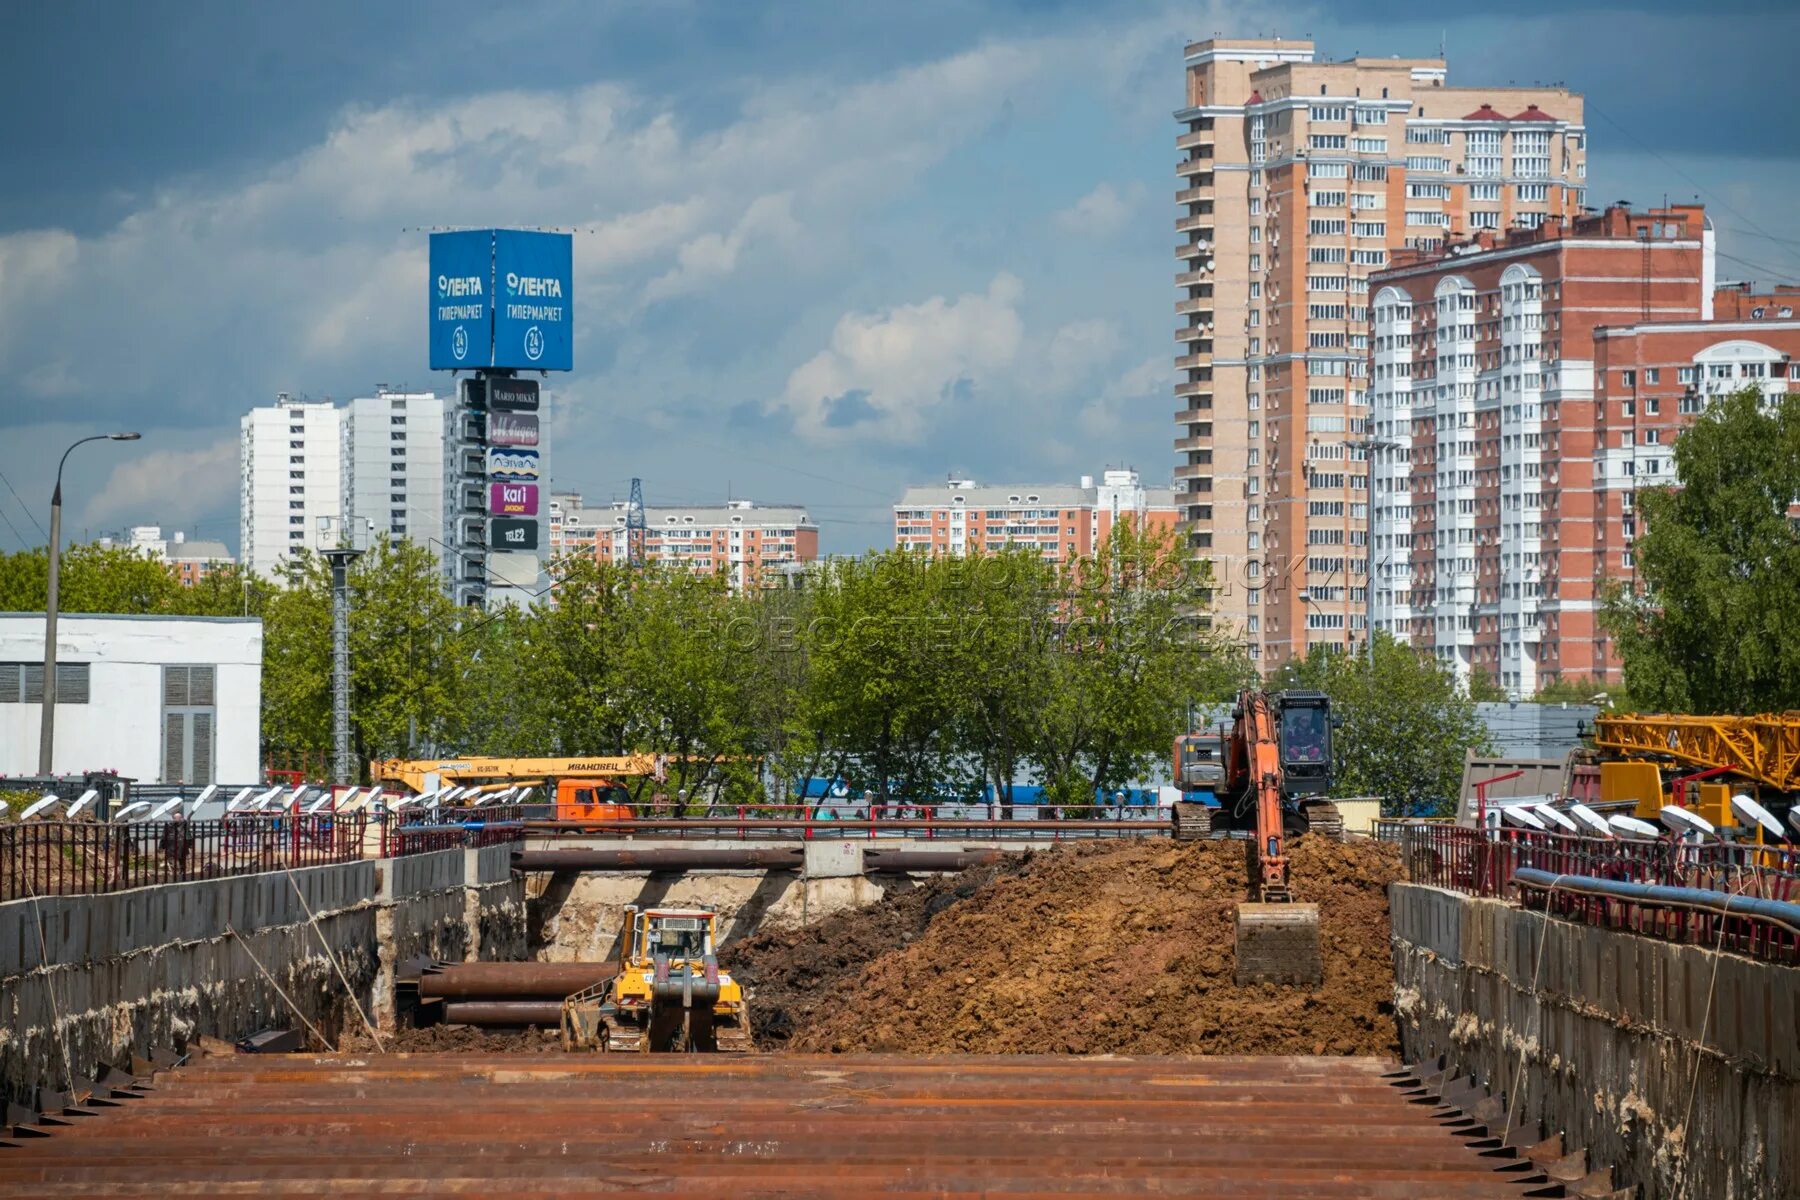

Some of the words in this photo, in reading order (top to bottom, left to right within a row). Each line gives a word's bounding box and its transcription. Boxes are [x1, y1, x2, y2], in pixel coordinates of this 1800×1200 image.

[447, 276, 482, 297] ЛЕНТА
[518, 277, 562, 298] ЛЕНТА
[438, 304, 483, 321] ГИПЕРМАРКЕТ
[507, 304, 562, 321] ГИПЕРМАРКЕТ
[455, 332, 464, 346] 24
[529, 332, 539, 346] 24
[494, 389, 515, 401] MARIO
[503, 486, 526, 503] kari
[505, 528, 525, 542] TELE2
[567, 762, 618, 771] ИВАНОВЕЦ
